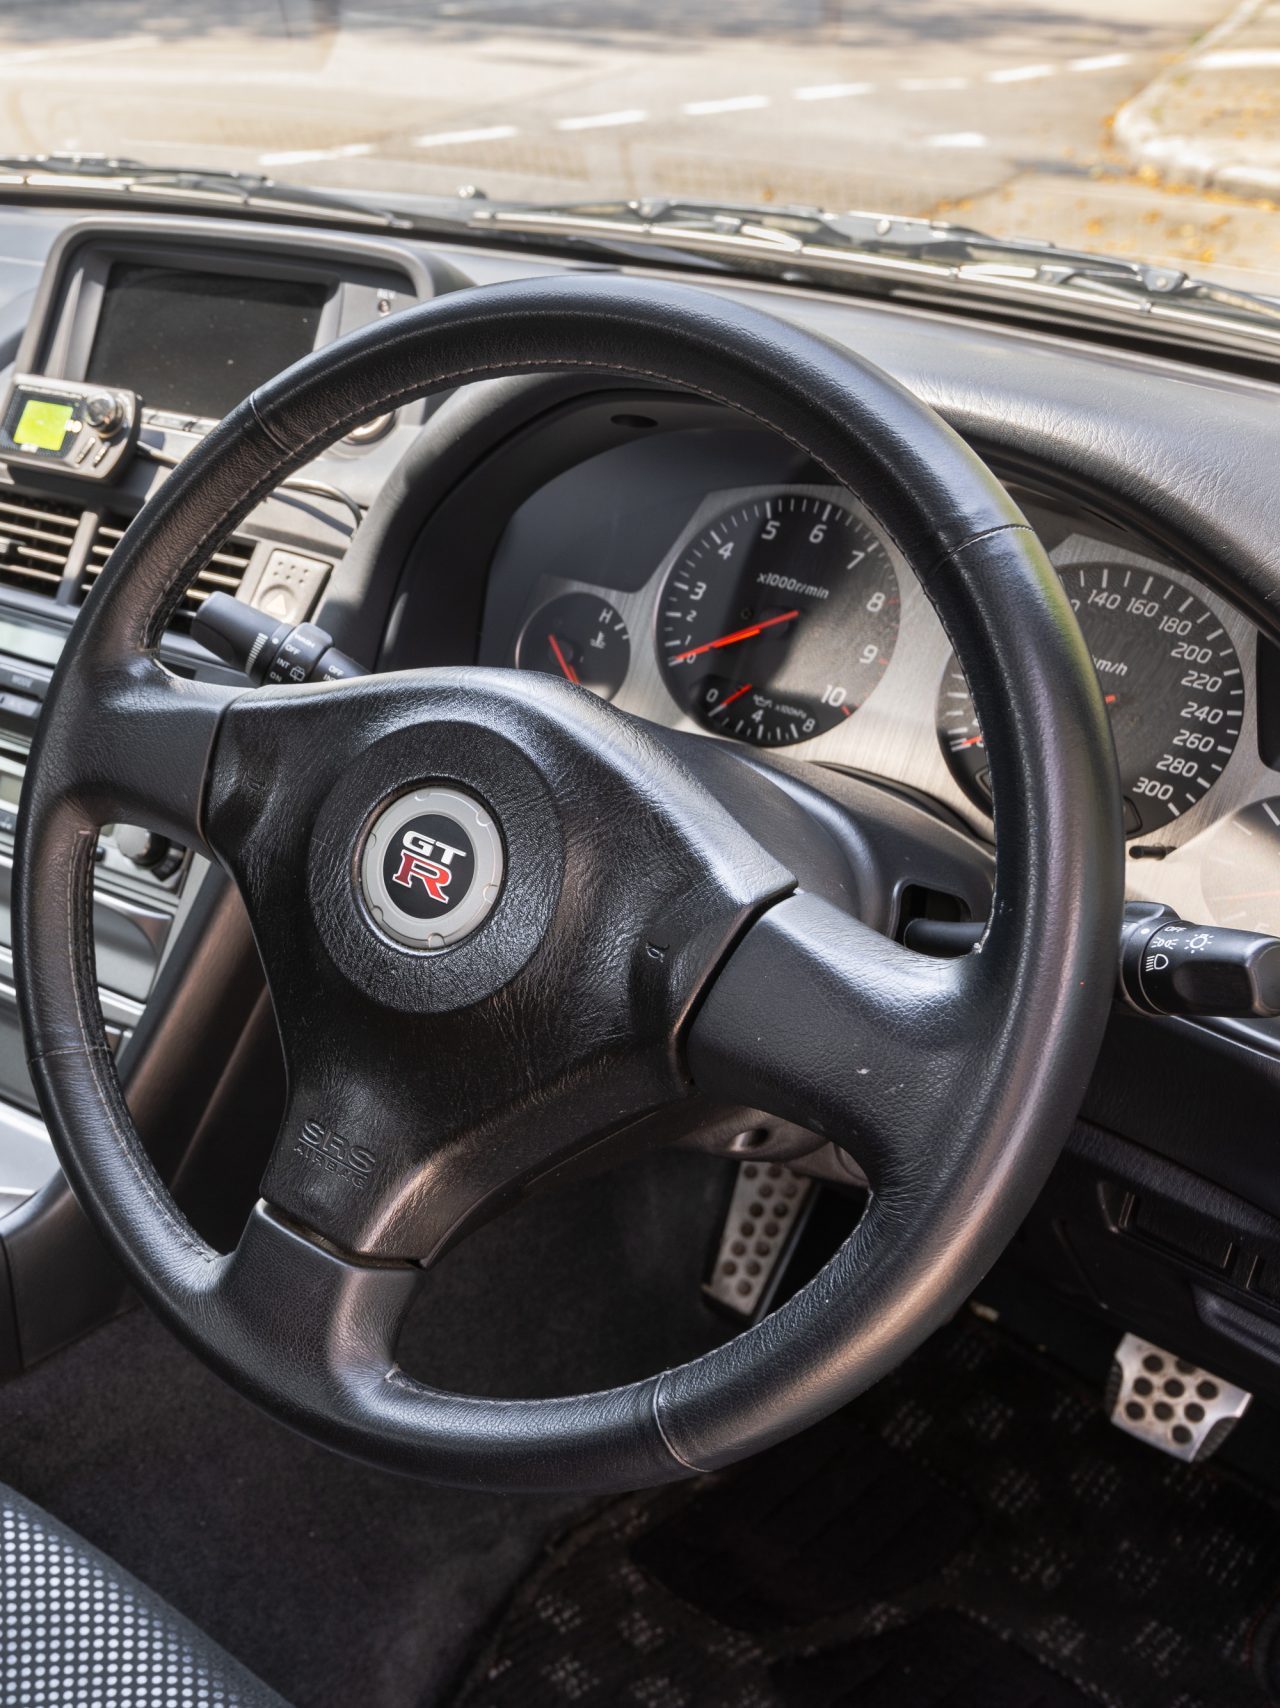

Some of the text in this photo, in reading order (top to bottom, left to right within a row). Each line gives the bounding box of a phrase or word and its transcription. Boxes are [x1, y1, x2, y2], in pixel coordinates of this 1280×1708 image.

[761, 521, 780, 540] 5
[809, 524, 827, 543] 6
[718, 541, 734, 560] 4
[846, 551, 865, 569] 7
[690, 582, 707, 601] 3
[756, 571, 829, 600] x1000r/min
[866, 592, 885, 613] 8
[1087, 589, 1121, 610] 140
[1126, 597, 1159, 617] 160
[598, 608, 613, 624] H
[686, 609, 697, 622] 2
[1158, 616, 1192, 636] 180
[685, 635, 692, 646] 1
[276, 657, 290, 669] INT
[859, 644, 878, 664] 9
[1170, 642, 1212, 664] 200
[270, 671, 282, 682] ON
[1180, 670, 1222, 692] 220
[706, 688, 718, 702] 0
[821, 684, 847, 707] 10
[751, 709, 764, 723] 4
[1180, 701, 1223, 724] 240
[802, 718, 816, 733] 8
[1172, 729, 1215, 752] 260
[1155, 754, 1198, 778] 280
[1132, 776, 1173, 800] 300
[402, 830, 467, 866] GT
[392, 849, 452, 905] R
[301, 1120, 377, 1173] SRS
